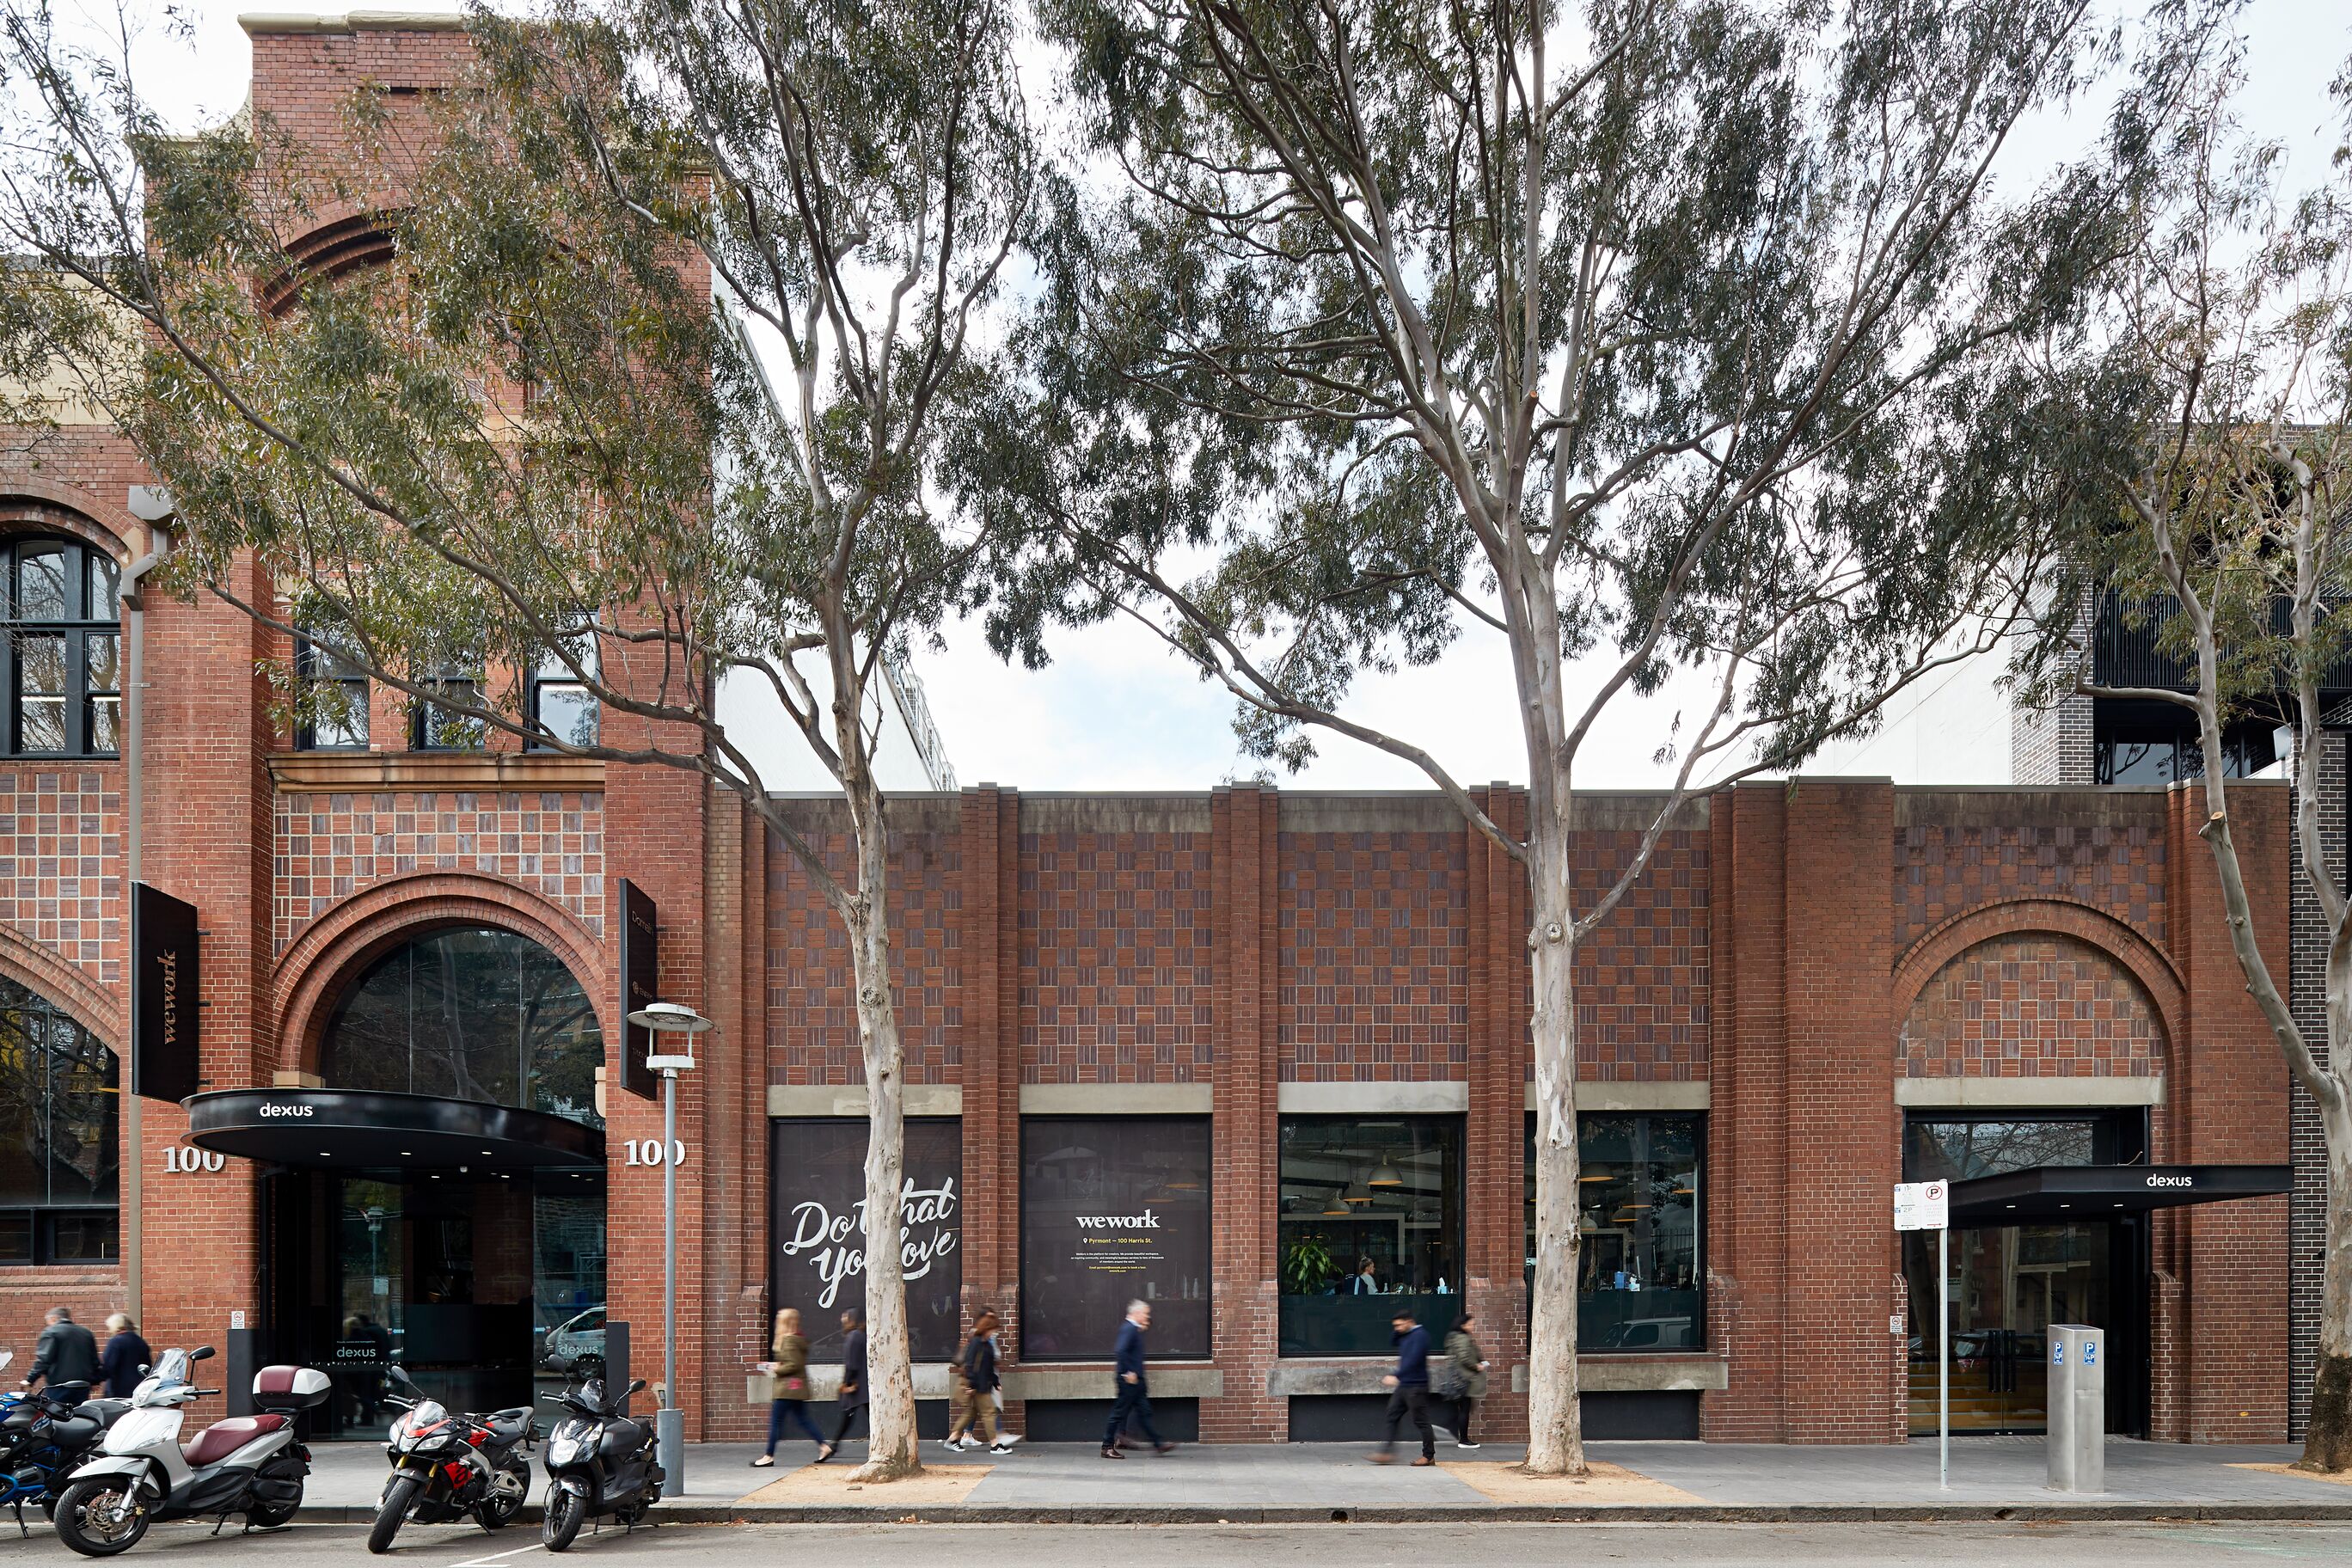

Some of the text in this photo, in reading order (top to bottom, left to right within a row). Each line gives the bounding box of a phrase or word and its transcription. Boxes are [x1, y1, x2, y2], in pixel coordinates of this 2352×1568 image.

[157, 949, 176, 1045] wework
[260, 1102, 313, 1117] dexus
[162, 1146, 224, 1173] 100
[624, 1139, 686, 1166] 100
[2147, 1173, 2192, 1187] dexus
[1075, 1209, 1161, 1228] wework
[783, 1201, 856, 1256] Do
[336, 1346, 377, 1357] dexus
[559, 1344, 599, 1355] dexus
[2086, 1344, 2094, 1353] P
